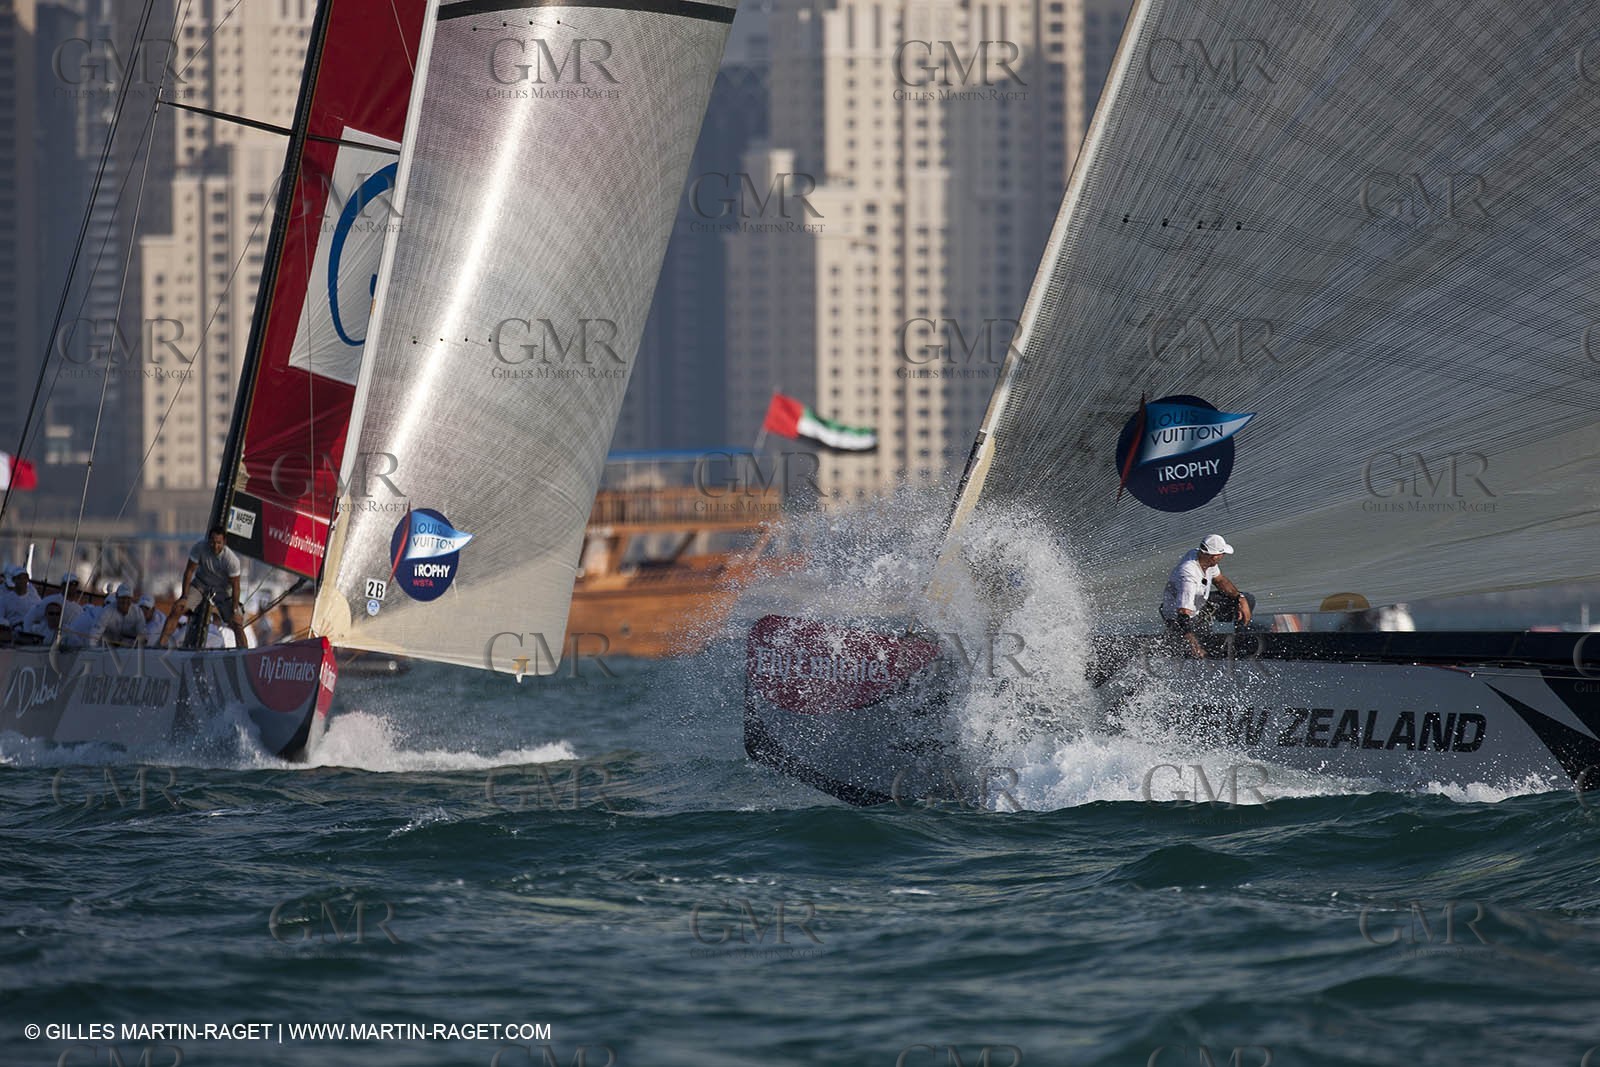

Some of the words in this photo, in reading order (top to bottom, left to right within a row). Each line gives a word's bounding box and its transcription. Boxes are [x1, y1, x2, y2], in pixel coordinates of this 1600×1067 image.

[1152, 410, 1198, 428] LOUIS
[1151, 425, 1224, 445] VUITTON
[1156, 459, 1220, 482] TROPHY
[1158, 482, 1195, 494] WSTA
[414, 522, 444, 534] LOUIS
[413, 537, 455, 550] VUITTON
[413, 564, 450, 578] TROPHY
[367, 581, 384, 598] 2B
[259, 655, 276, 684] Fly
[275, 656, 316, 682] Emirates
[1278, 707, 1487, 753] ZEALAND
